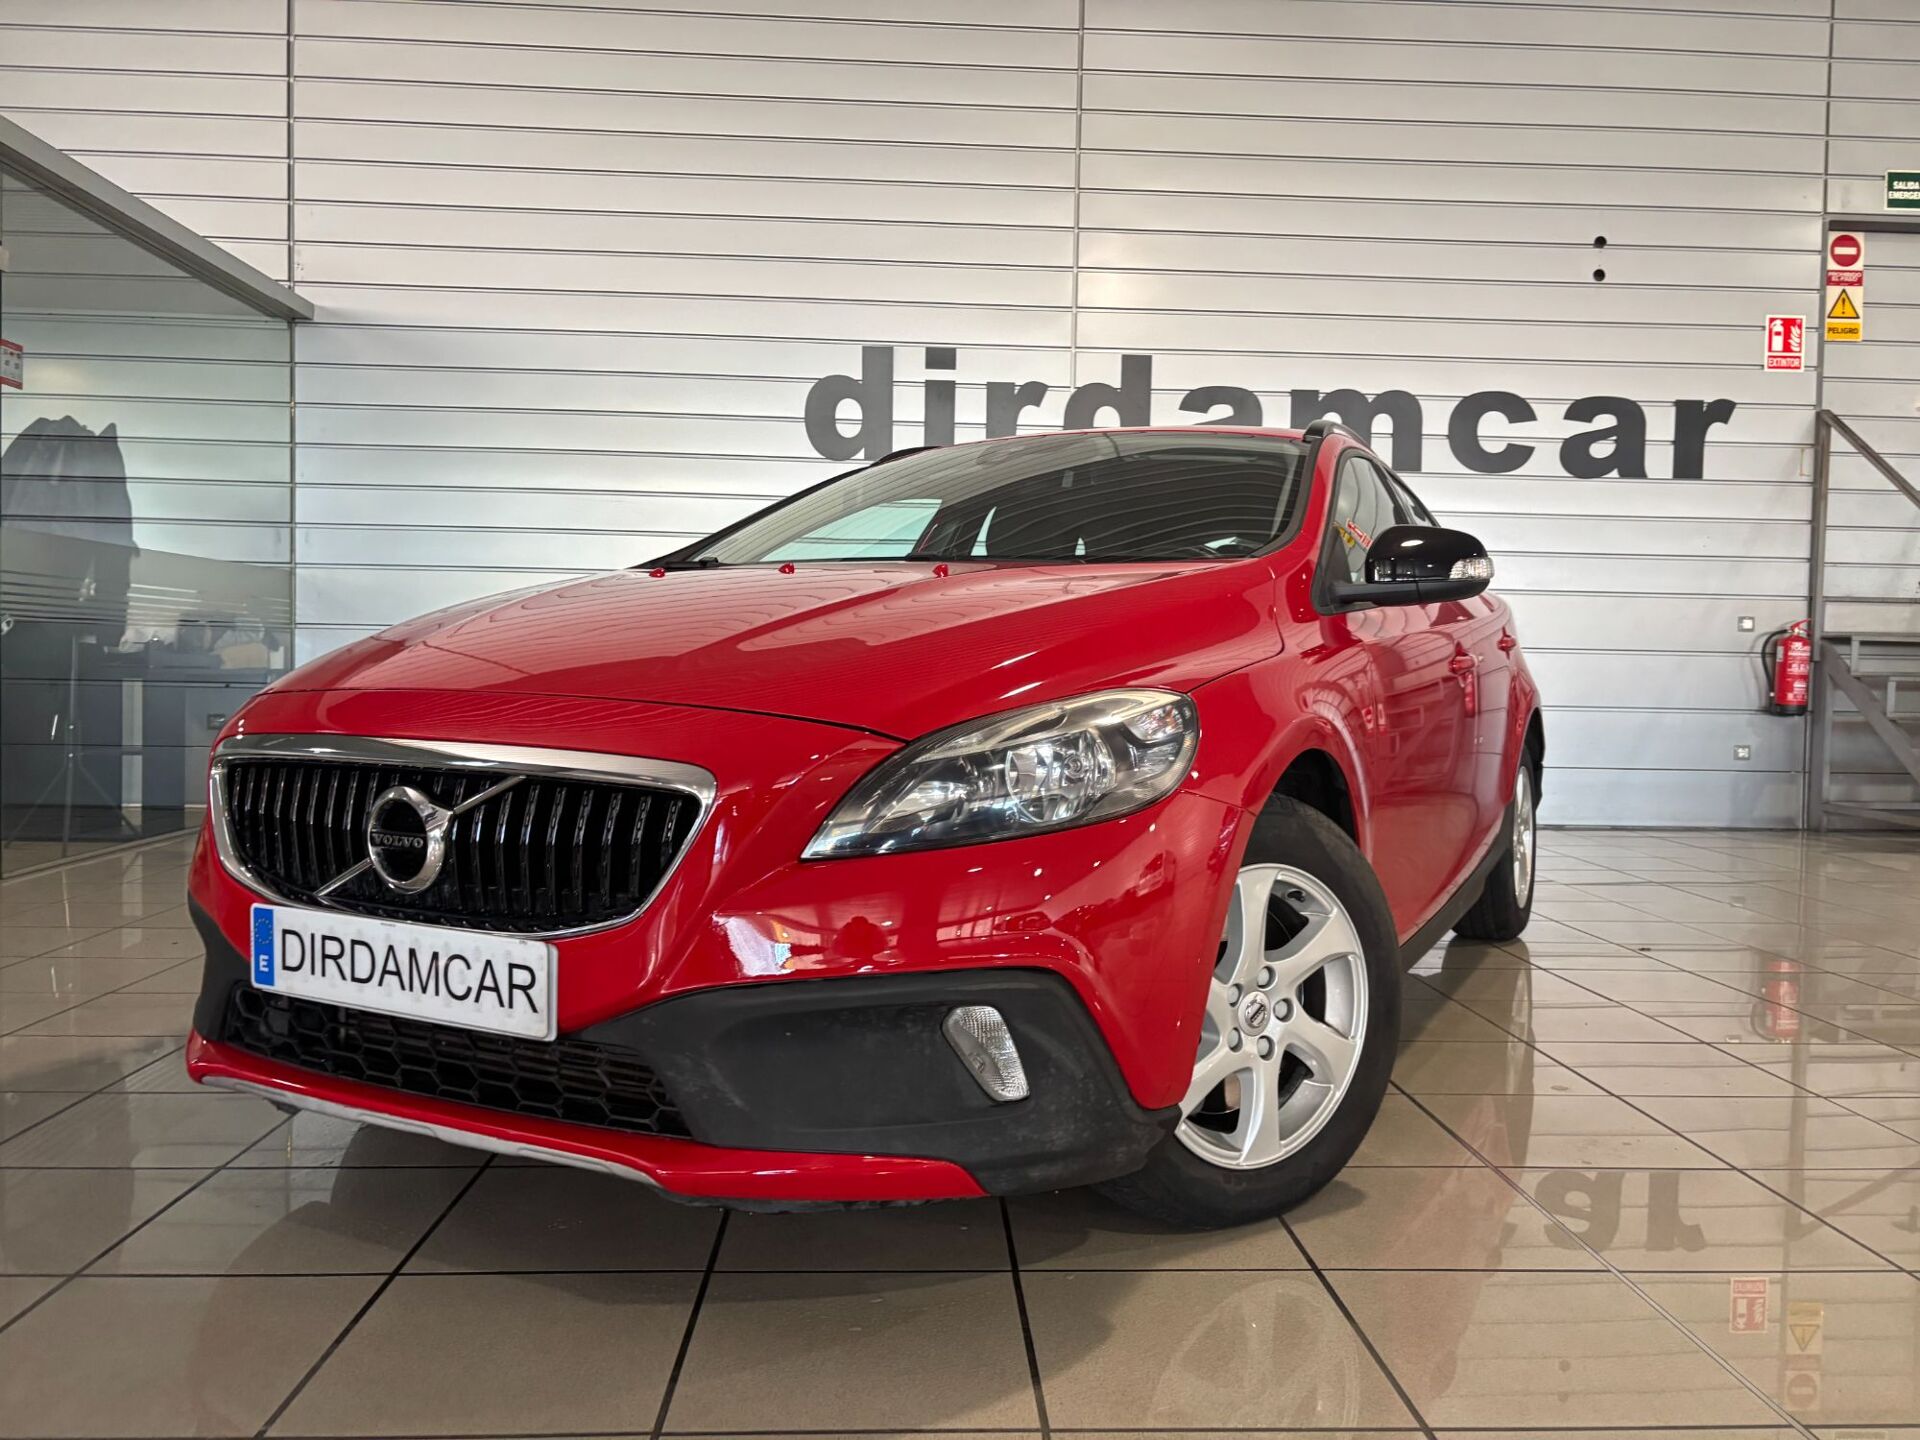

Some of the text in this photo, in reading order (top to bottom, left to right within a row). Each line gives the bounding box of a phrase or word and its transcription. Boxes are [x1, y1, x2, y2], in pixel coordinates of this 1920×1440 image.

[1889, 191, 1920, 200] EMERGE
[1768, 358, 1801, 367] EXTINTOR
[371, 833, 424, 848] VOLVO
[259, 954, 270, 972] E
[281, 928, 539, 1014] DIRDAMCAR
